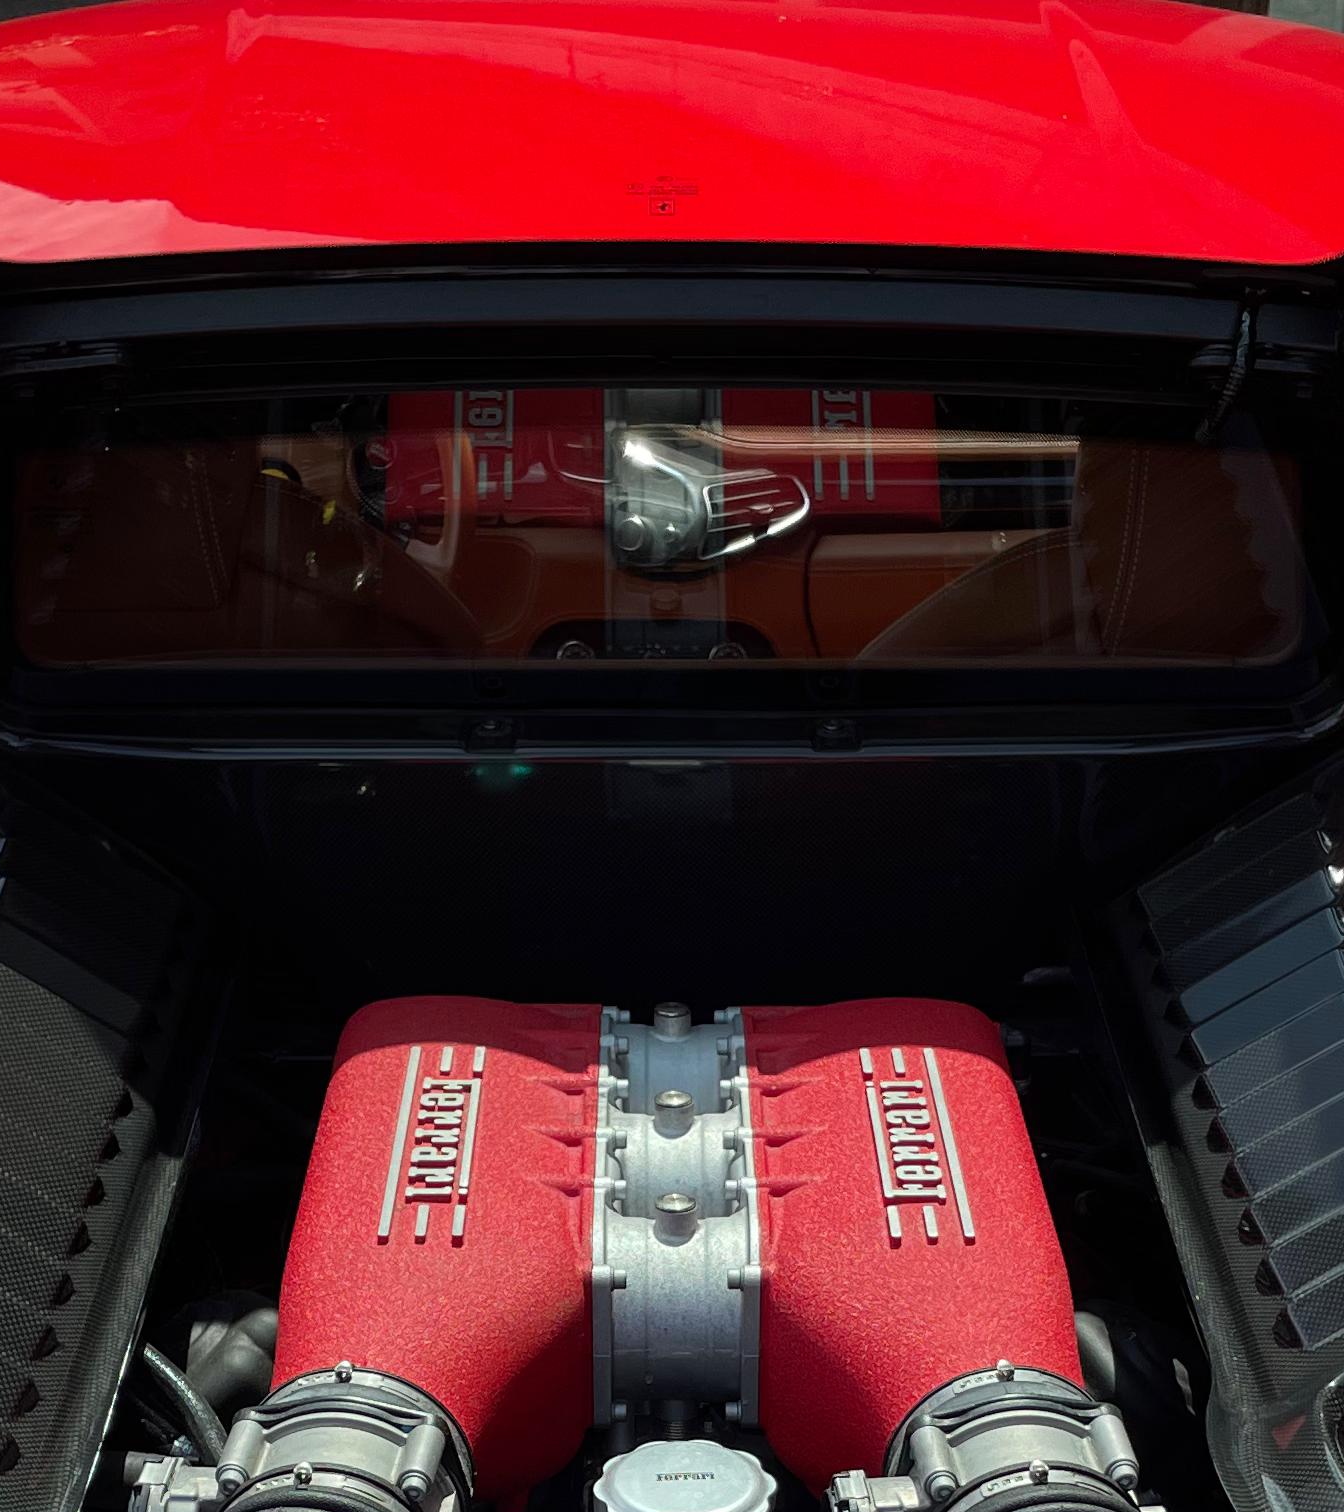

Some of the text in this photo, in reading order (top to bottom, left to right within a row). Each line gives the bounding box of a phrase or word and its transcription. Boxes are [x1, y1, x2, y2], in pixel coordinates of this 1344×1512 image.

[405, 1077, 481, 1199] Ferrari
[866, 1080, 947, 1200] Ferrari
[656, 1471, 715, 1482] Ferrari
